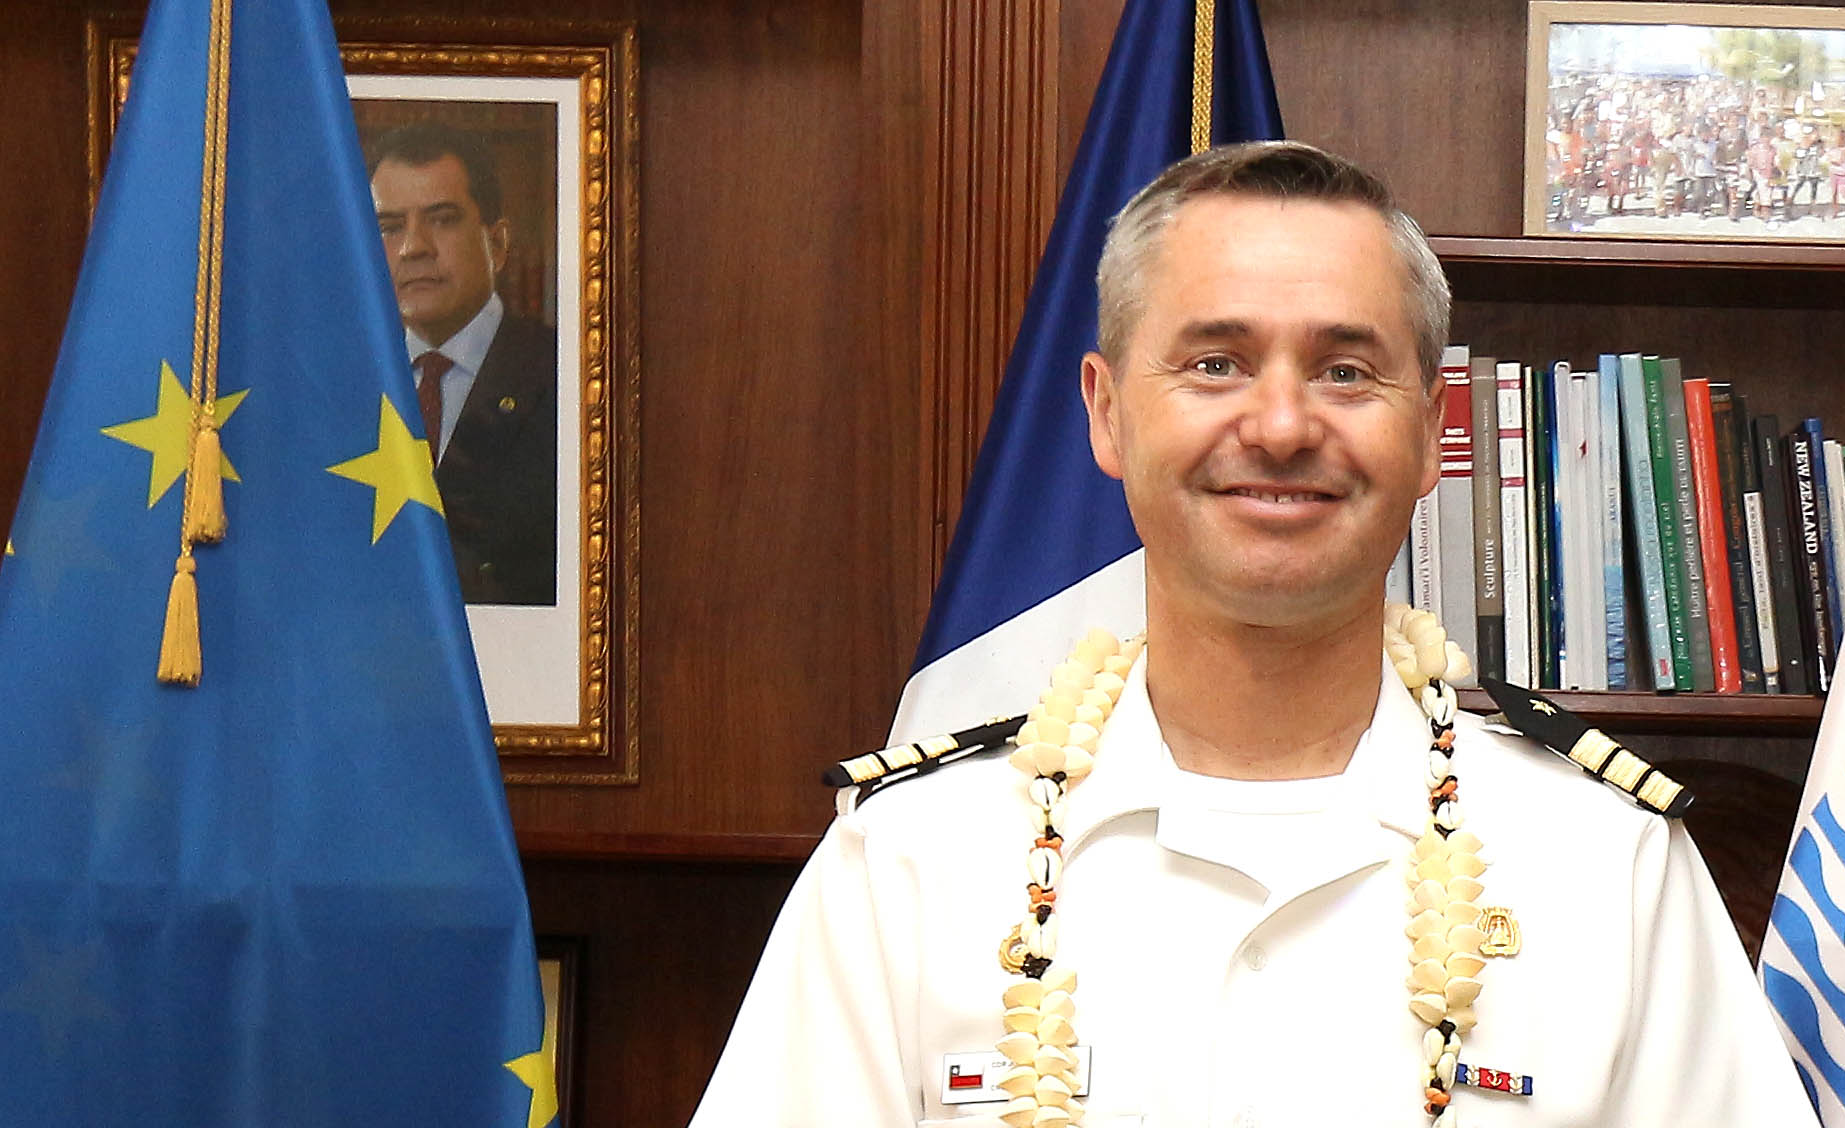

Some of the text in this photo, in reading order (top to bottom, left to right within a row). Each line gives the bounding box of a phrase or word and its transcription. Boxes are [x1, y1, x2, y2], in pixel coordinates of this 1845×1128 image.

[1795, 441, 1810, 477] NEW
[1676, 490, 1695, 520] perle
[1798, 480, 1818, 554] ZEALAND
[1682, 523, 1693, 535] et
[1418, 499, 1431, 614] amari'i Volontaires
[1482, 538, 1497, 600] Sculpture
[1684, 536, 1701, 580] perlière
